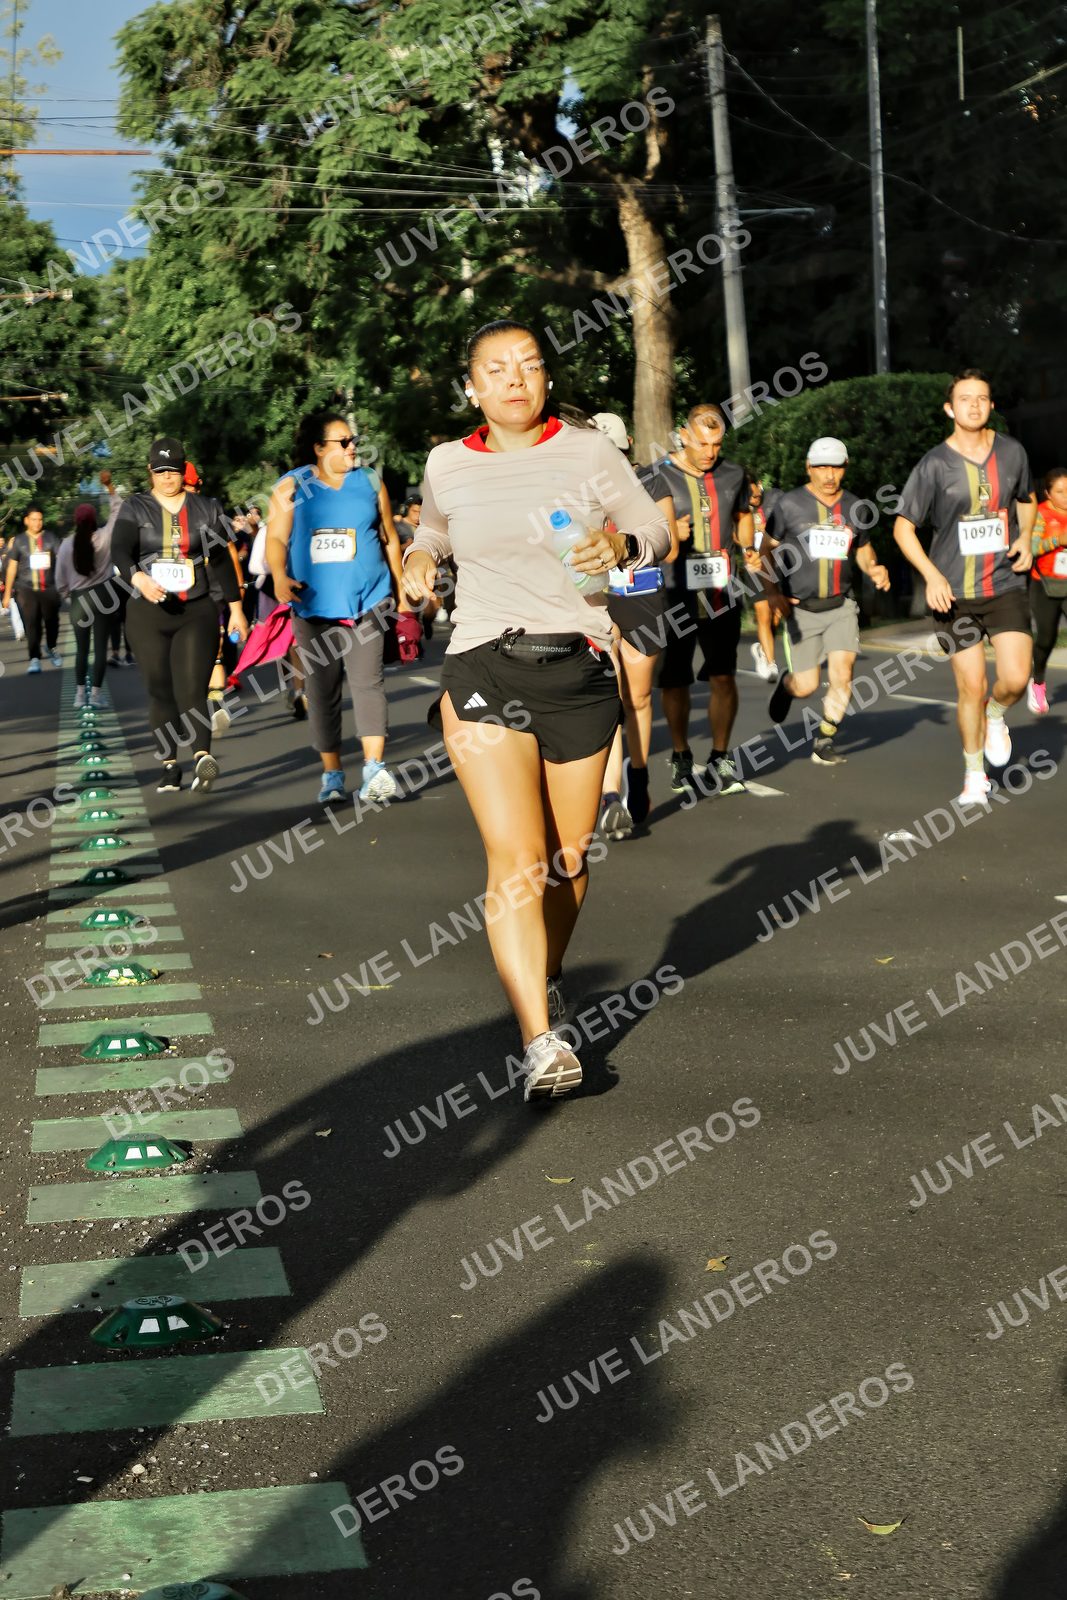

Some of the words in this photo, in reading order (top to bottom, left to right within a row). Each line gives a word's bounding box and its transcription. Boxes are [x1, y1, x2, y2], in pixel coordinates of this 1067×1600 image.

[962, 524, 1003, 540] 10976
[316, 538, 346, 550] 2564
[814, 534, 846, 547] 12746
[693, 562, 721, 576] 9833
